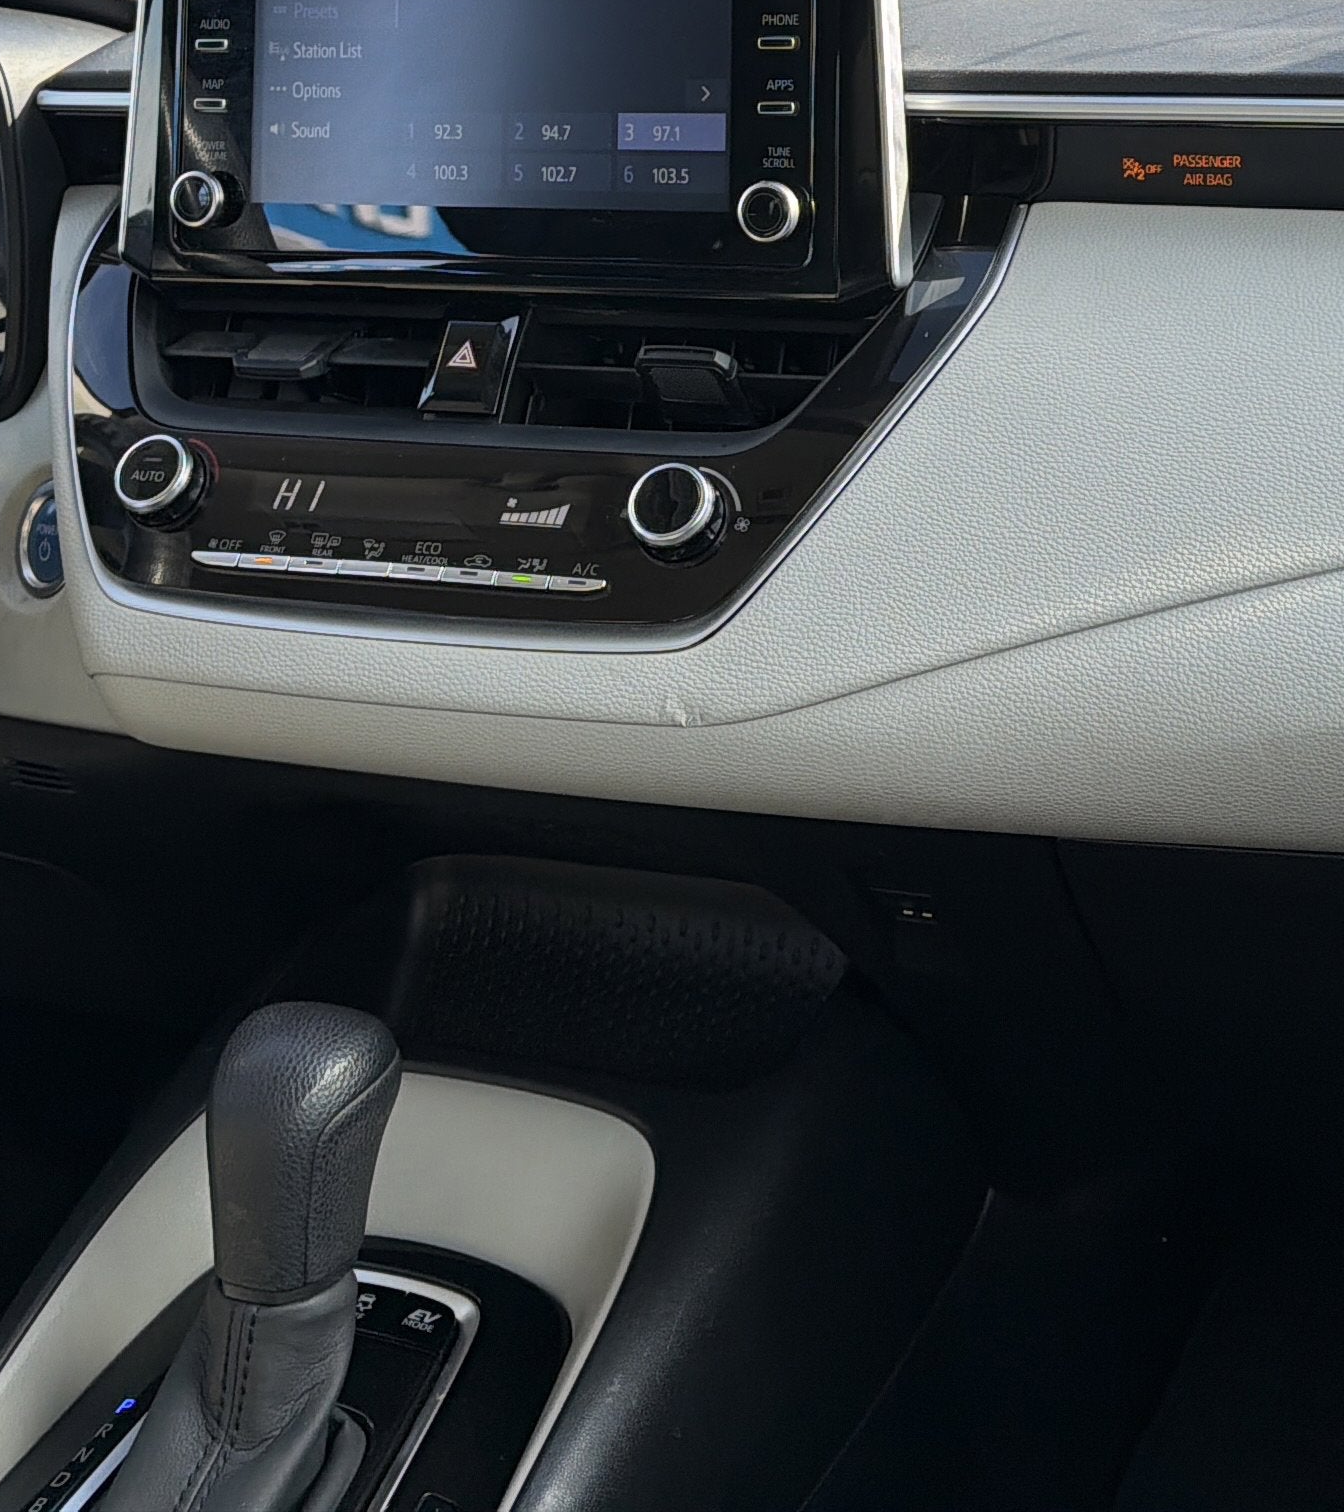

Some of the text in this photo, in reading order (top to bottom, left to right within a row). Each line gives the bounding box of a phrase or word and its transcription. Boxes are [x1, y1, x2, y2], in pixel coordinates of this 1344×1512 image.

[294, 2, 339, 20] Presets
[199, 18, 231, 31] AUDIO
[761, 13, 801, 26] PHONE
[293, 41, 363, 59] Station List
[202, 78, 225, 90] MAP
[292, 81, 342, 102] Options
[766, 79, 795, 92] APPS
[291, 121, 331, 139] Sound
[434, 124, 463, 140] 92.3
[514, 123, 572, 141] 2 94.7
[624, 123, 681, 142] 3 97.1
[767, 146, 792, 157] TUNE
[762, 157, 795, 169] SCROLL
[1145, 164, 1162, 174] OFF
[1173, 154, 1242, 168] PASSENGER
[407, 163, 468, 181] 4 100.3
[514, 164, 577, 182] 5 102.7
[623, 165, 690, 184] 6 103.5
[1183, 173, 1233, 186] AIR BAG
[130, 469, 166, 483] AUTO
[219, 538, 244, 550] OFF
[259, 544, 287, 554] FRONT
[414, 541, 443, 556] ECO
[311, 548, 334, 557] REAR
[401, 553, 449, 566] HEAT/COOL
[571, 562, 601, 576] A/C
[407, 1308, 443, 1324] EV
[400, 1317, 435, 1334] MODE
[115, 1397, 136, 1415] P
[93, 1422, 114, 1439] R
[72, 1446, 95, 1463] N
[49, 1470, 72, 1488] D
[28, 1496, 49, 1512] B
